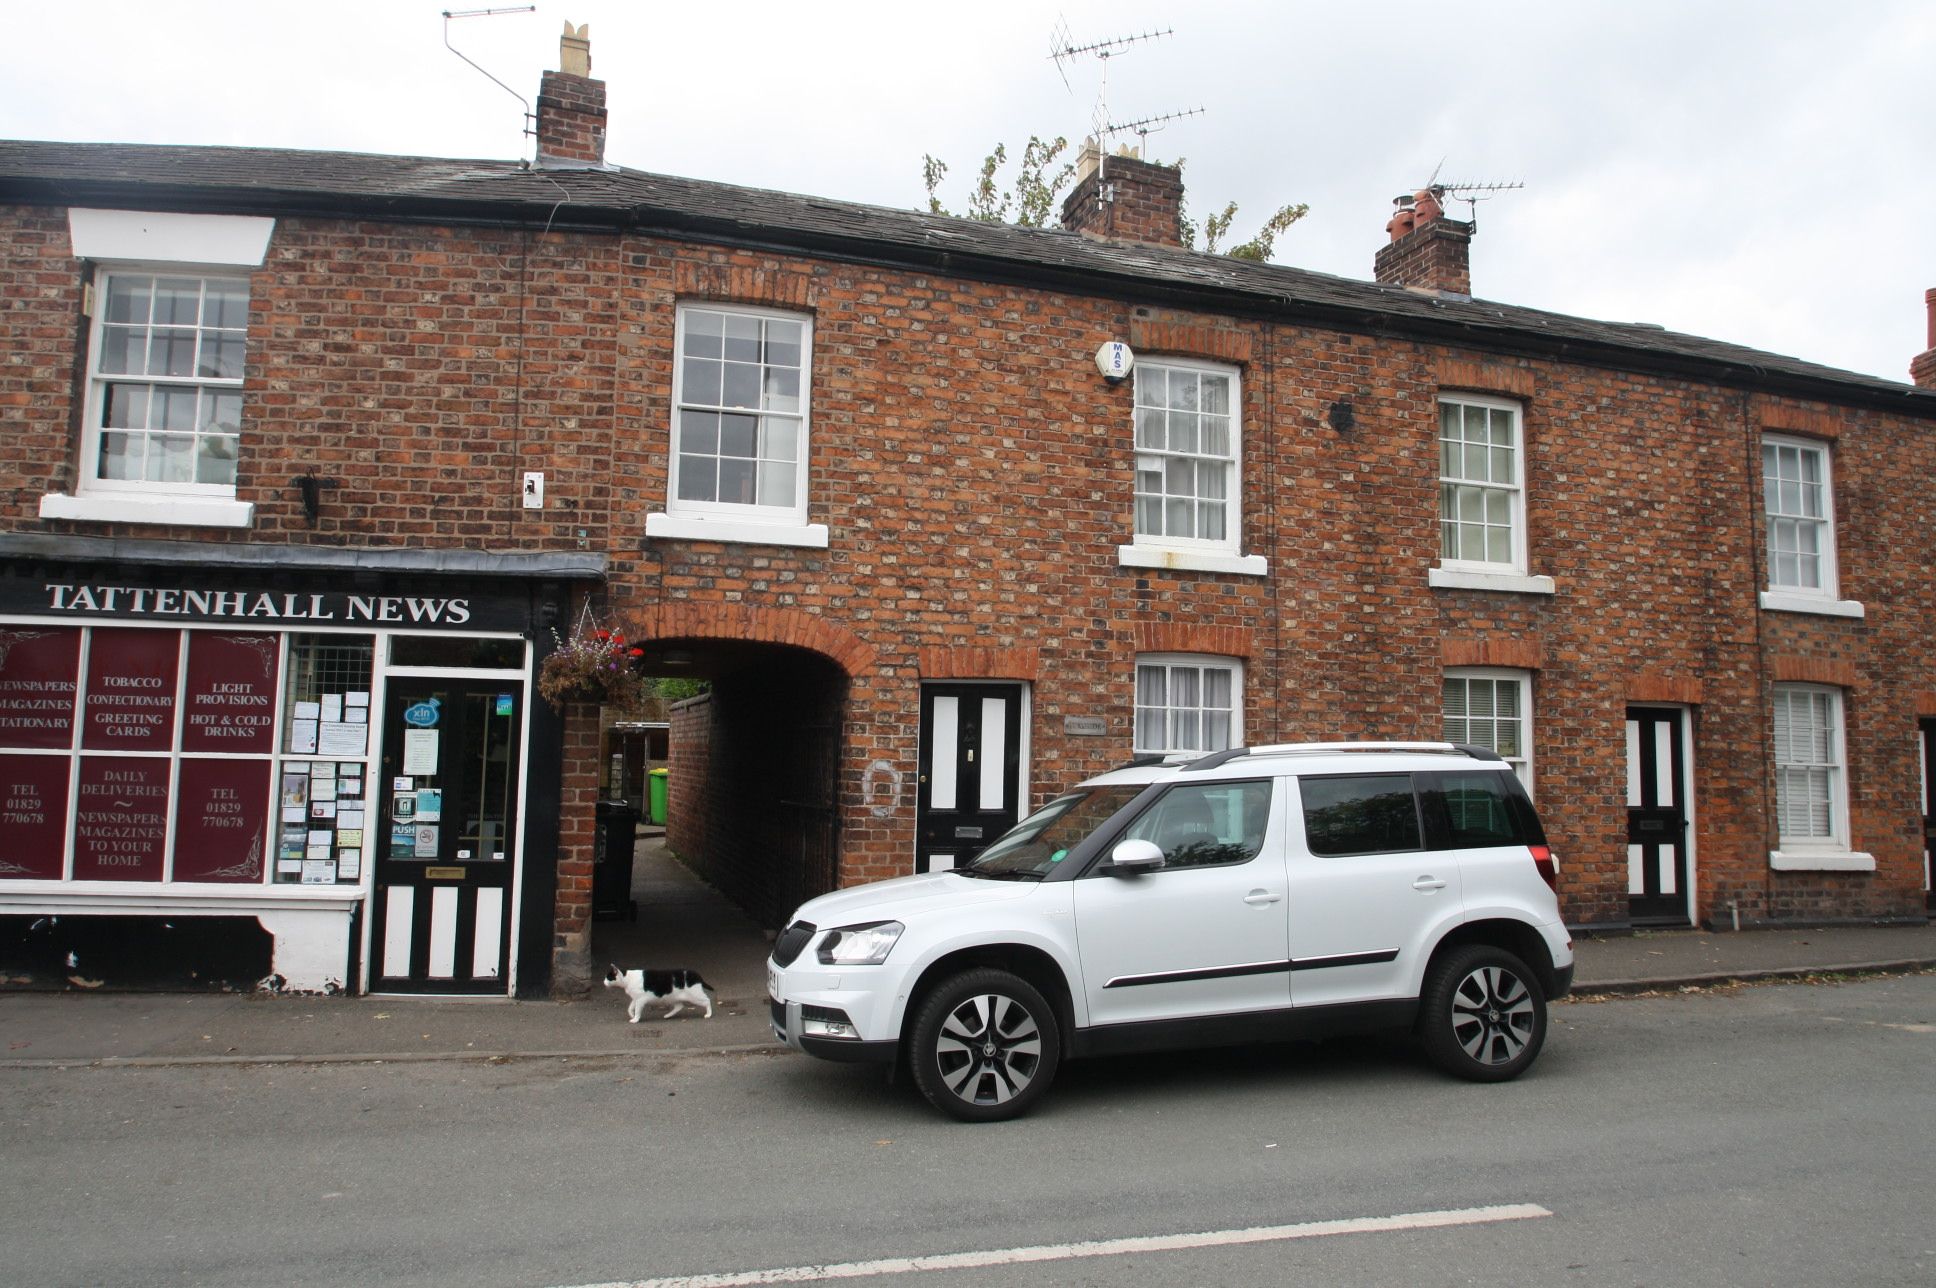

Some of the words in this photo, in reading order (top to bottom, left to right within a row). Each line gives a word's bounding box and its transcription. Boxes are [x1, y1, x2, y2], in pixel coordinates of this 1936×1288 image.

[1113, 343, 1123, 368] MAS
[45, 584, 333, 620] TATTENHALL
[346, 595, 471, 624] NEWS
[0, 681, 76, 692] EWSPAPERS
[103, 676, 162, 688] TOBACCO
[212, 683, 254, 694] LIGHT
[87, 694, 174, 706] CONFECTIONARY
[196, 694, 268, 706] PROVISIONS
[0, 717, 71, 728] TATIONARY
[95, 713, 163, 725] GREETING
[190, 714, 217, 725] HOT
[221, 715, 231, 725] &
[235, 715, 271, 726] COLD
[106, 725, 151, 737] CARDS
[204, 726, 256, 738] DRINKS
[104, 770, 148, 782] DAILY
[11, 784, 39, 796] TEL
[81, 783, 168, 797] DELIVERIES
[211, 788, 239, 800] TEL
[7, 798, 42, 810] 01829
[206, 802, 241, 813] 01829
[3, 812, 45, 824] 770678
[203, 816, 244, 828] 770678
[79, 826, 164, 839] MAGAZINES
[392, 825, 416, 835] PUSH
[88, 840, 108, 852] TO
[112, 841, 152, 853] YOUR
[98, 854, 142, 867] HOME
